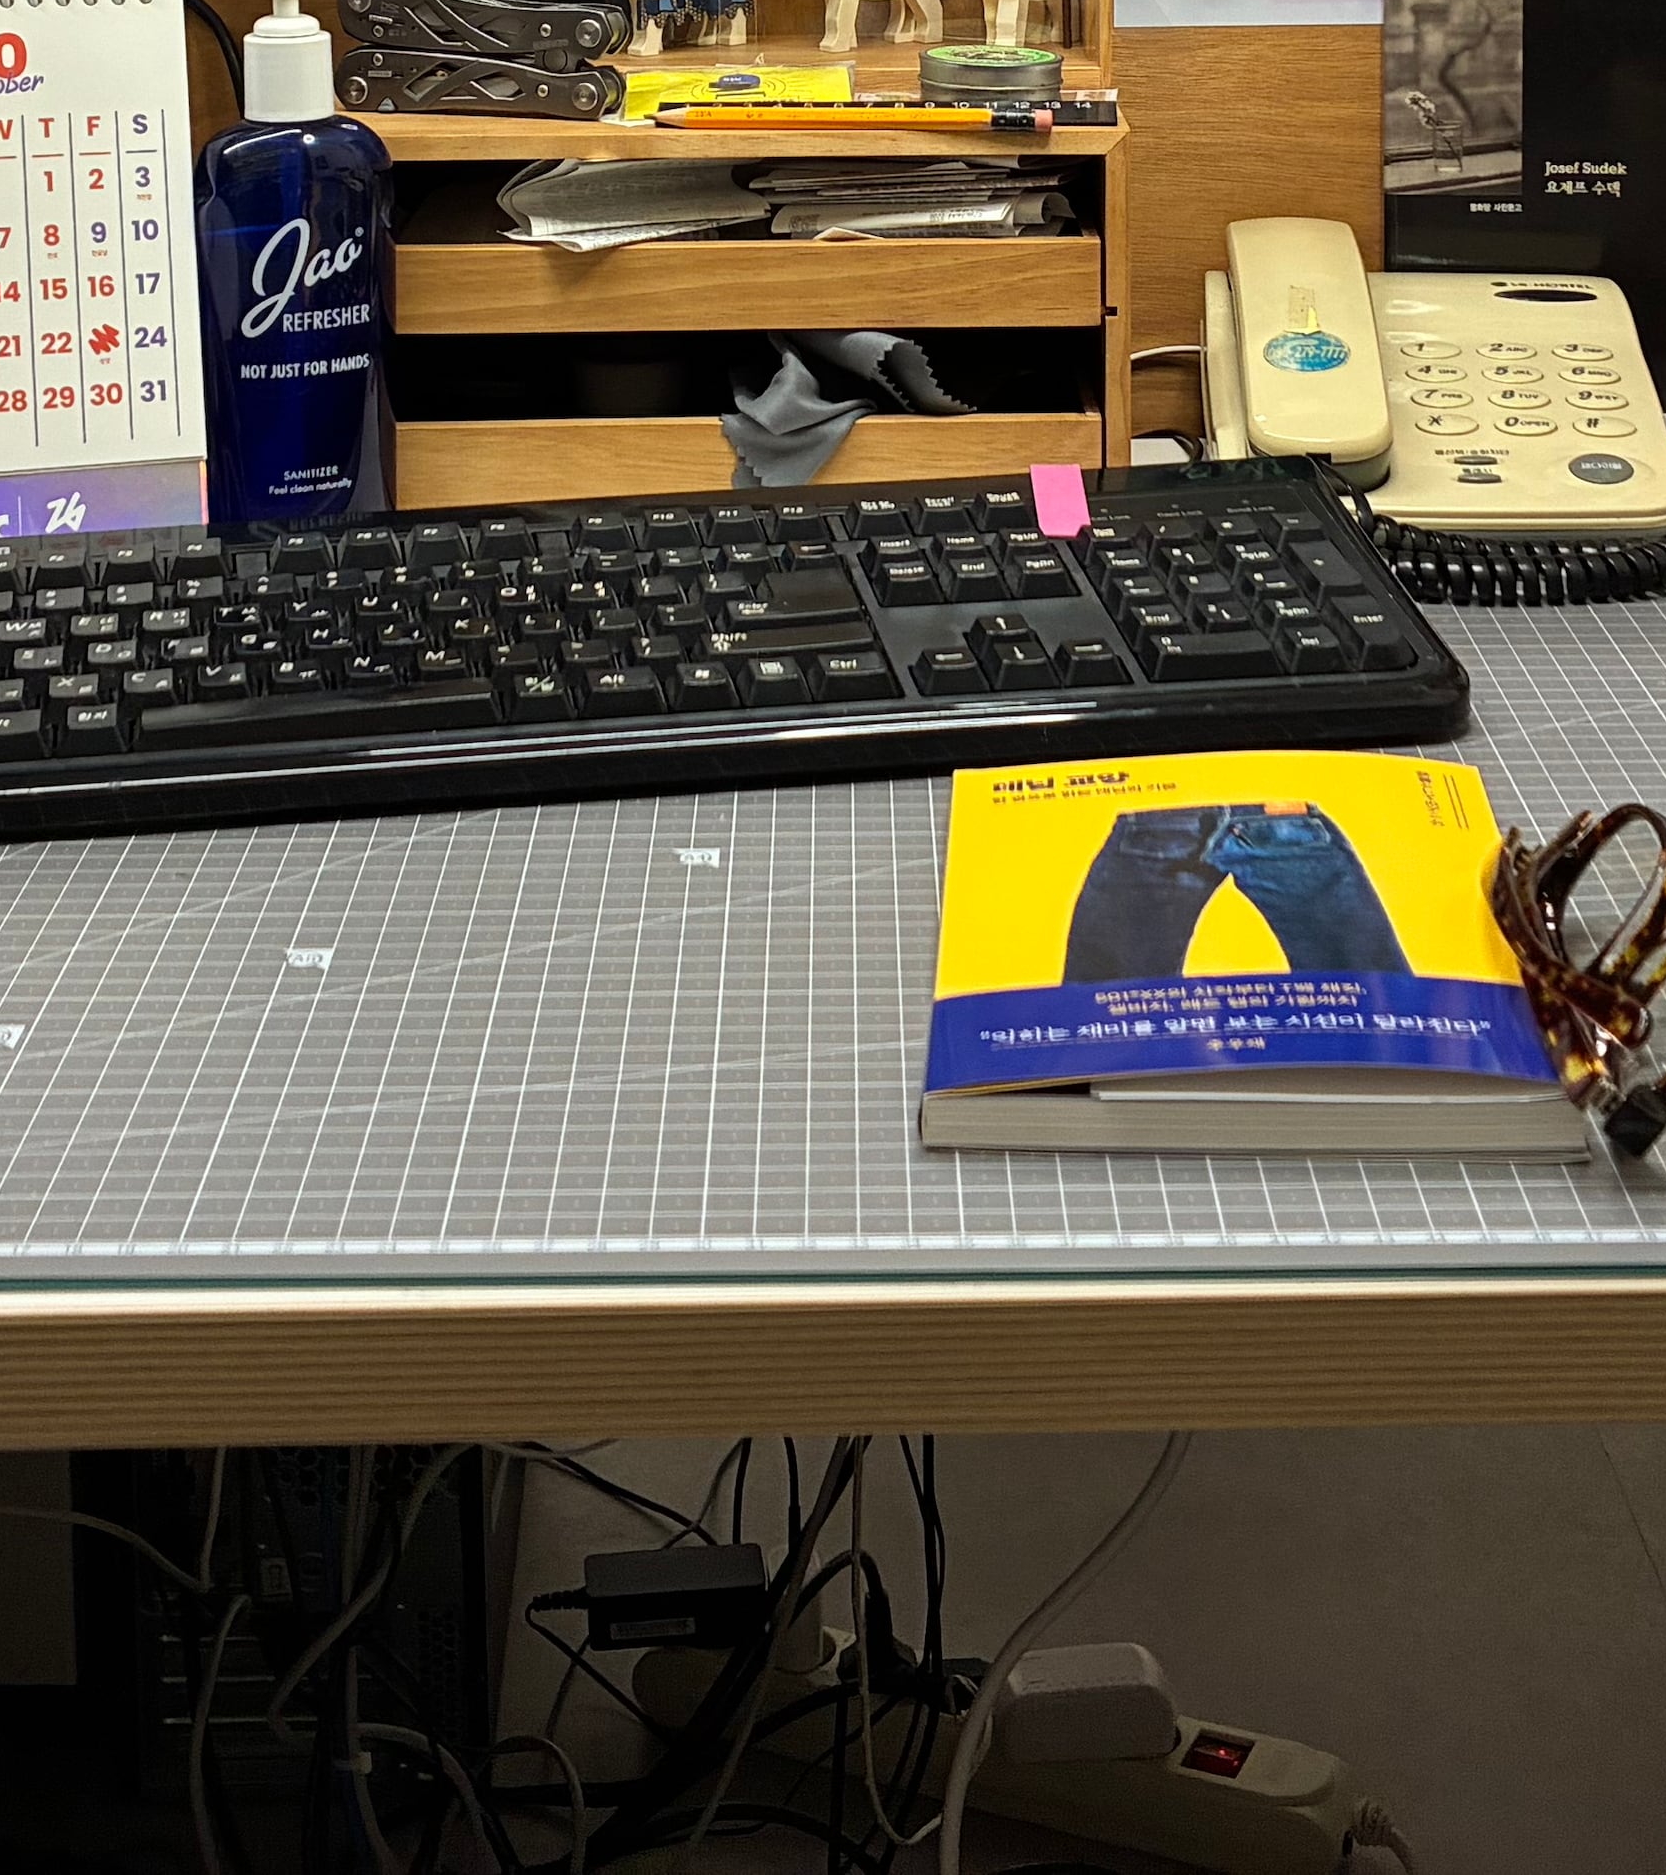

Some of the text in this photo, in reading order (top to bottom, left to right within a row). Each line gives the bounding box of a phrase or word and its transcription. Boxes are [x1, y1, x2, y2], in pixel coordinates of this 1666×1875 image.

[39, 117, 55, 139] T
[87, 116, 102, 137] F
[132, 113, 149, 136] S
[44, 166, 151, 192] 1 2 3
[1544, 160, 1627, 176] Josef Sudek
[1544, 179, 1622, 197] 요제프 수덱
[240, 217, 364, 338] Jao
[282, 303, 371, 333] REFRESHER
[240, 353, 370, 380] NOT JUST FOR HANDS
[42, 386, 76, 409] 29
[89, 383, 124, 406] 30
[140, 379, 168, 402] 31
[283, 465, 339, 481] SANITIZER
[269, 478, 352, 495] Feel clean naturally
[1163, 1015, 1216, 1034] 알면
[1229, 1014, 1279, 1031] 보는
[1287, 1012, 1364, 1031] 시선이
